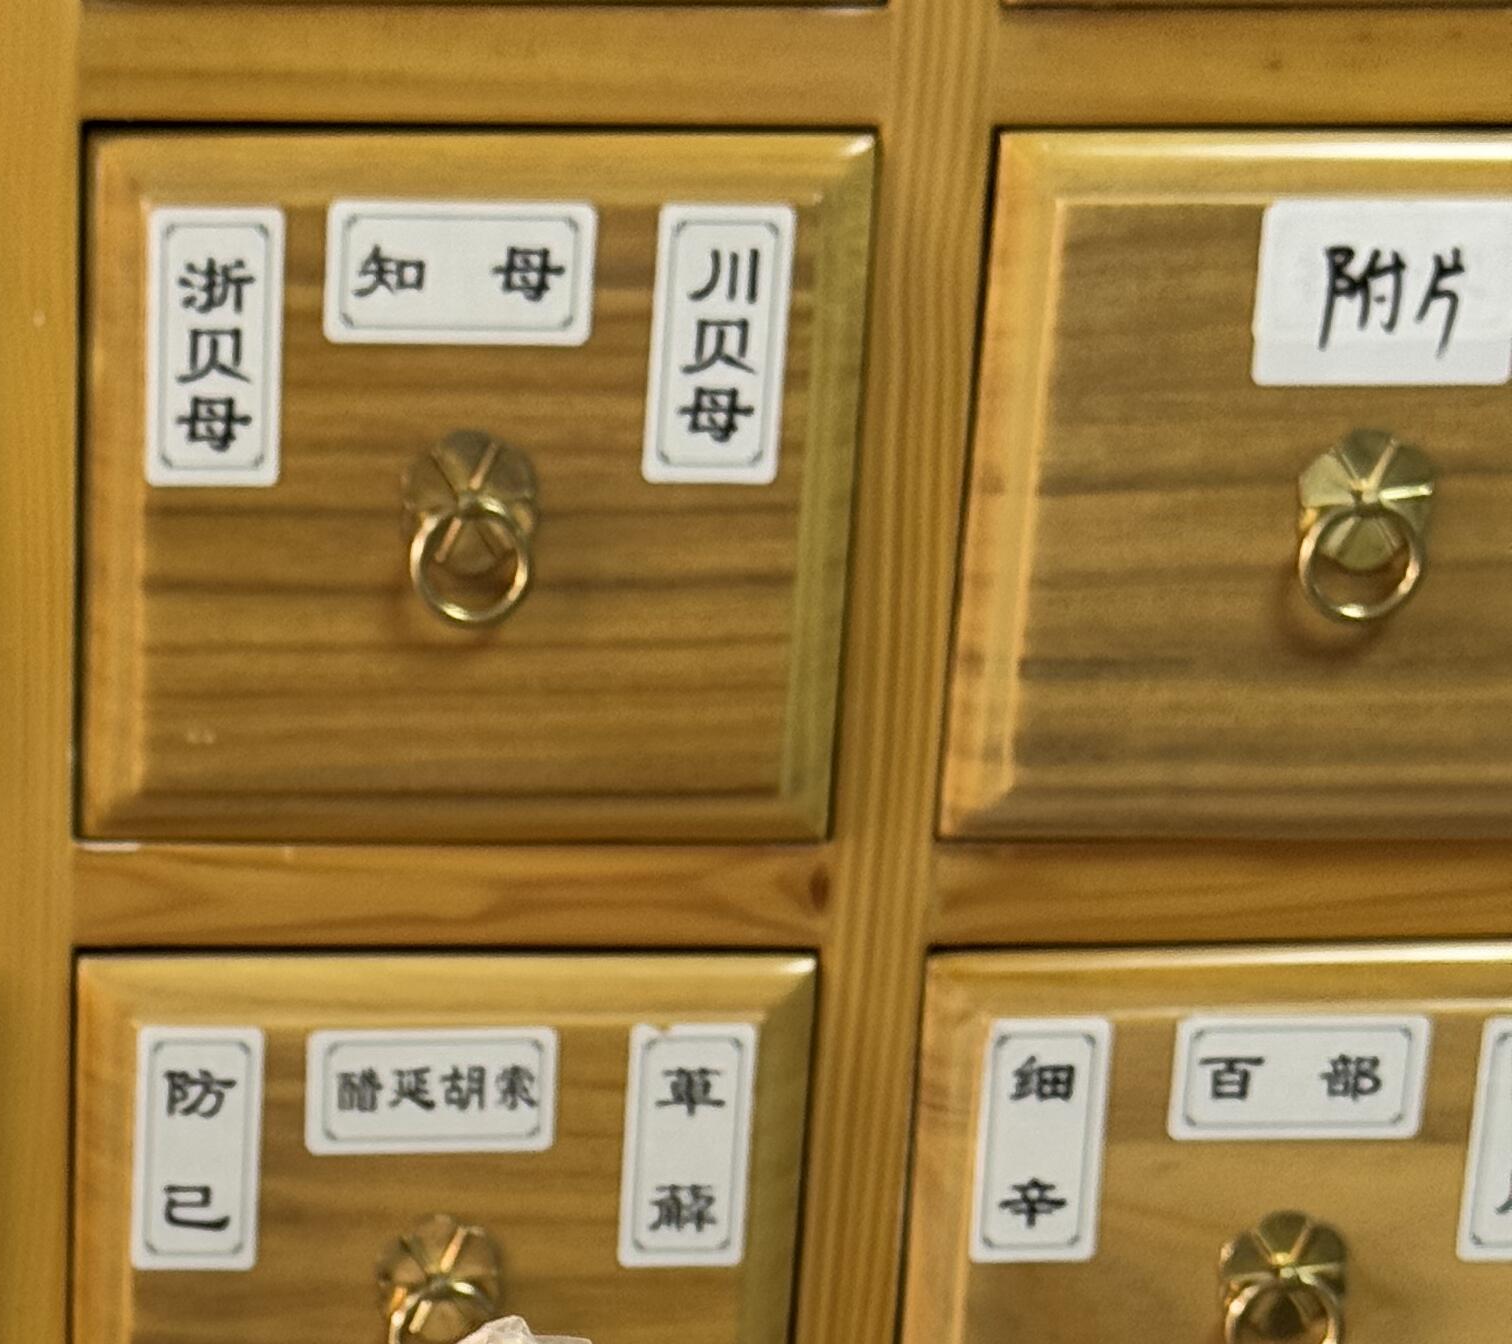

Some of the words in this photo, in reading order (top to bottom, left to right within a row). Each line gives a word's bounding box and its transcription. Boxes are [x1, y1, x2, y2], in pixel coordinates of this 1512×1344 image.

[352, 243, 567, 304] 知母
[1317, 243, 1467, 355] 附片
[174, 256, 258, 454] 浙贝母
[676, 246, 759, 445] 川贝母
[335, 1063, 541, 1114] 醋延胡索
[997, 1054, 1078, 1230] 细辛
[1197, 1052, 1384, 1103] 百部
[162, 1067, 239, 1234] 防己
